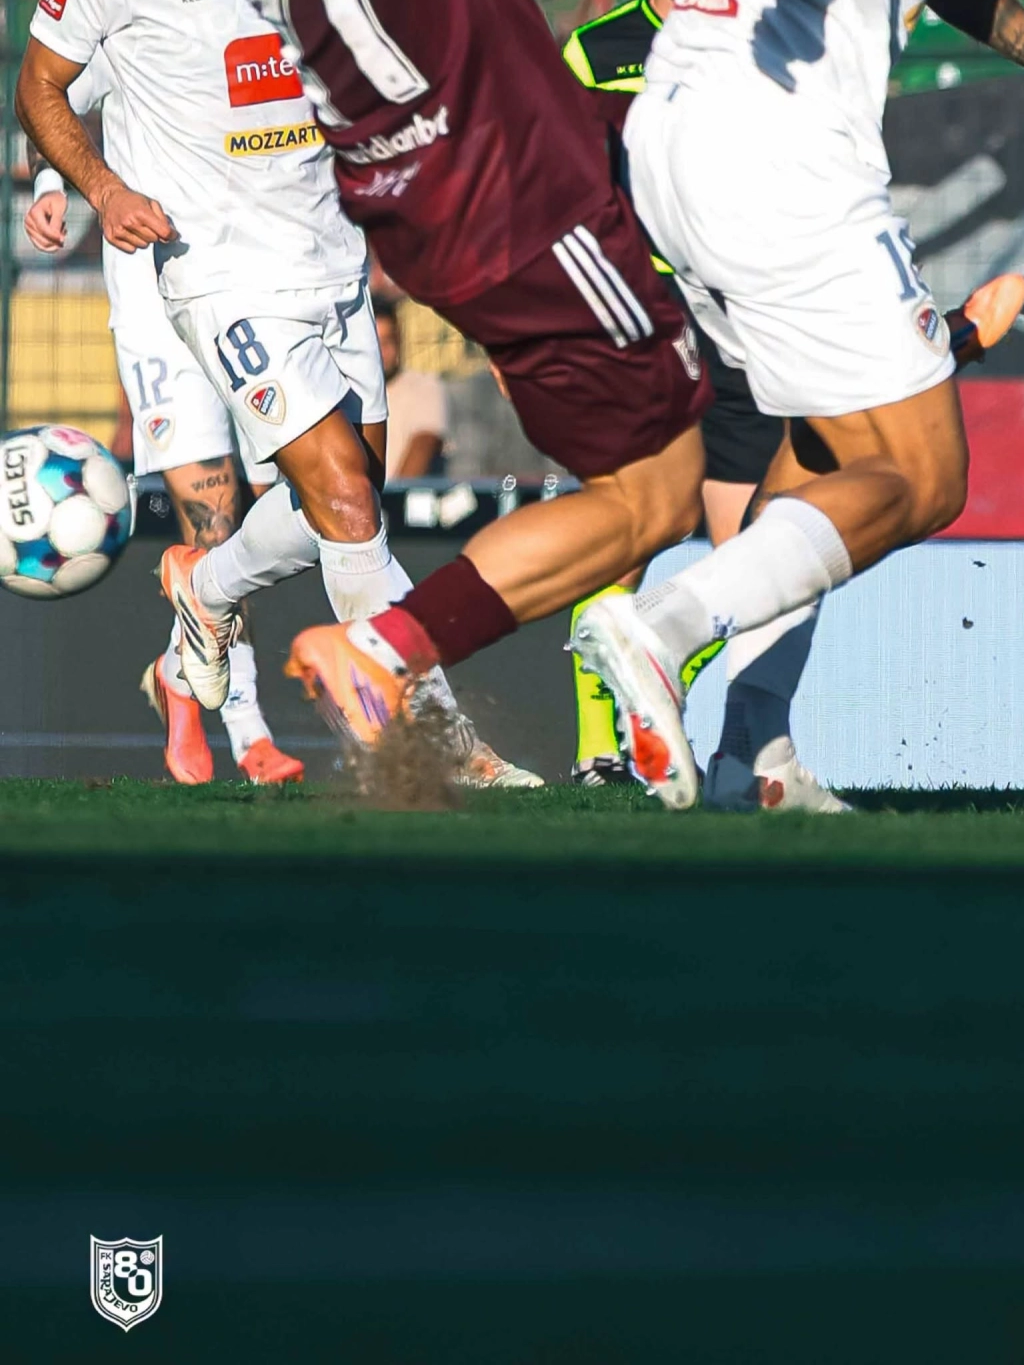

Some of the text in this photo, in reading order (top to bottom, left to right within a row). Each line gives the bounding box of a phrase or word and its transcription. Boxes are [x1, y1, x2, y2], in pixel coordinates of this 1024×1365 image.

[236, 55, 301, 83] m:te
[230, 125, 318, 153] MOZZART
[213, 318, 271, 393] 18
[132, 356, 174, 412] 12
[5, 445, 35, 527] SELECT
